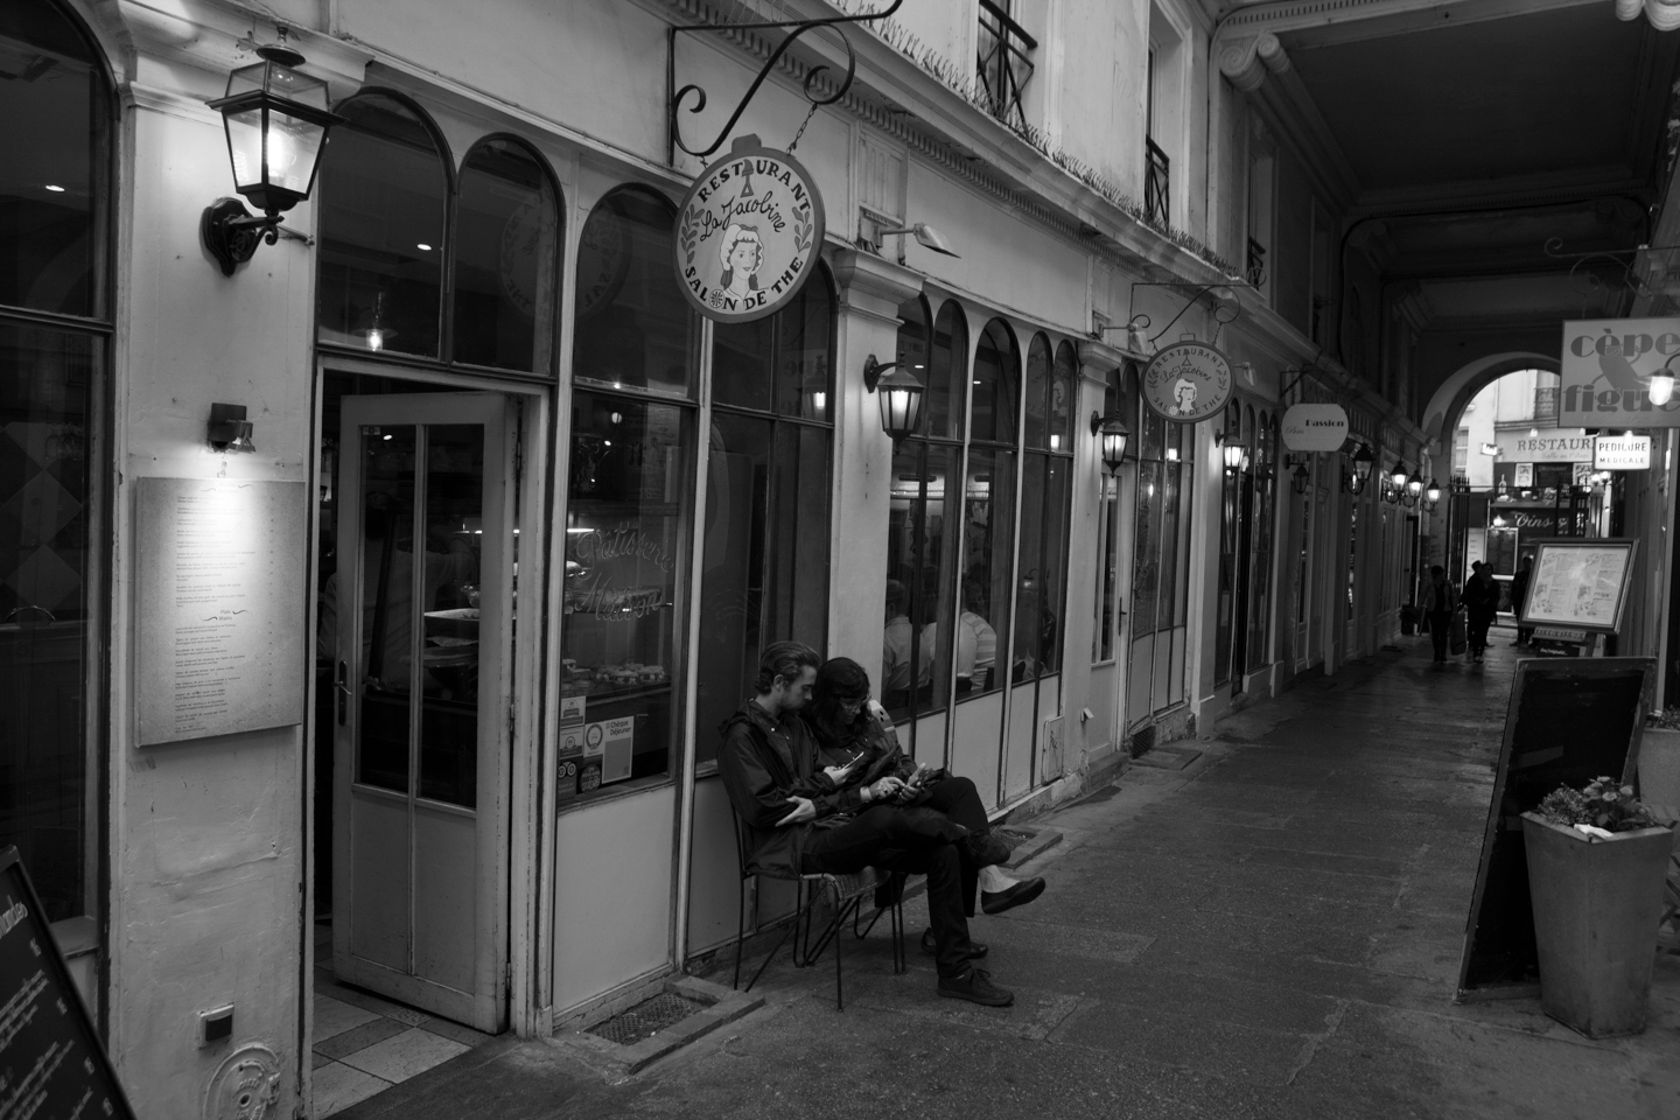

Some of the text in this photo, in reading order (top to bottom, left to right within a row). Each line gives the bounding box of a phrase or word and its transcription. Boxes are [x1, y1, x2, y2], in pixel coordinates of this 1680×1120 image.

[698, 159, 811, 212] RESTAURANT
[700, 190, 786, 242] La Jacobine
[686, 256, 804, 311] SALON DE THE
[1155, 348, 1224, 368] RESTAURANT
[1571, 328, 1680, 358] cèpe
[1517, 438, 1593, 451] RESTAUR
